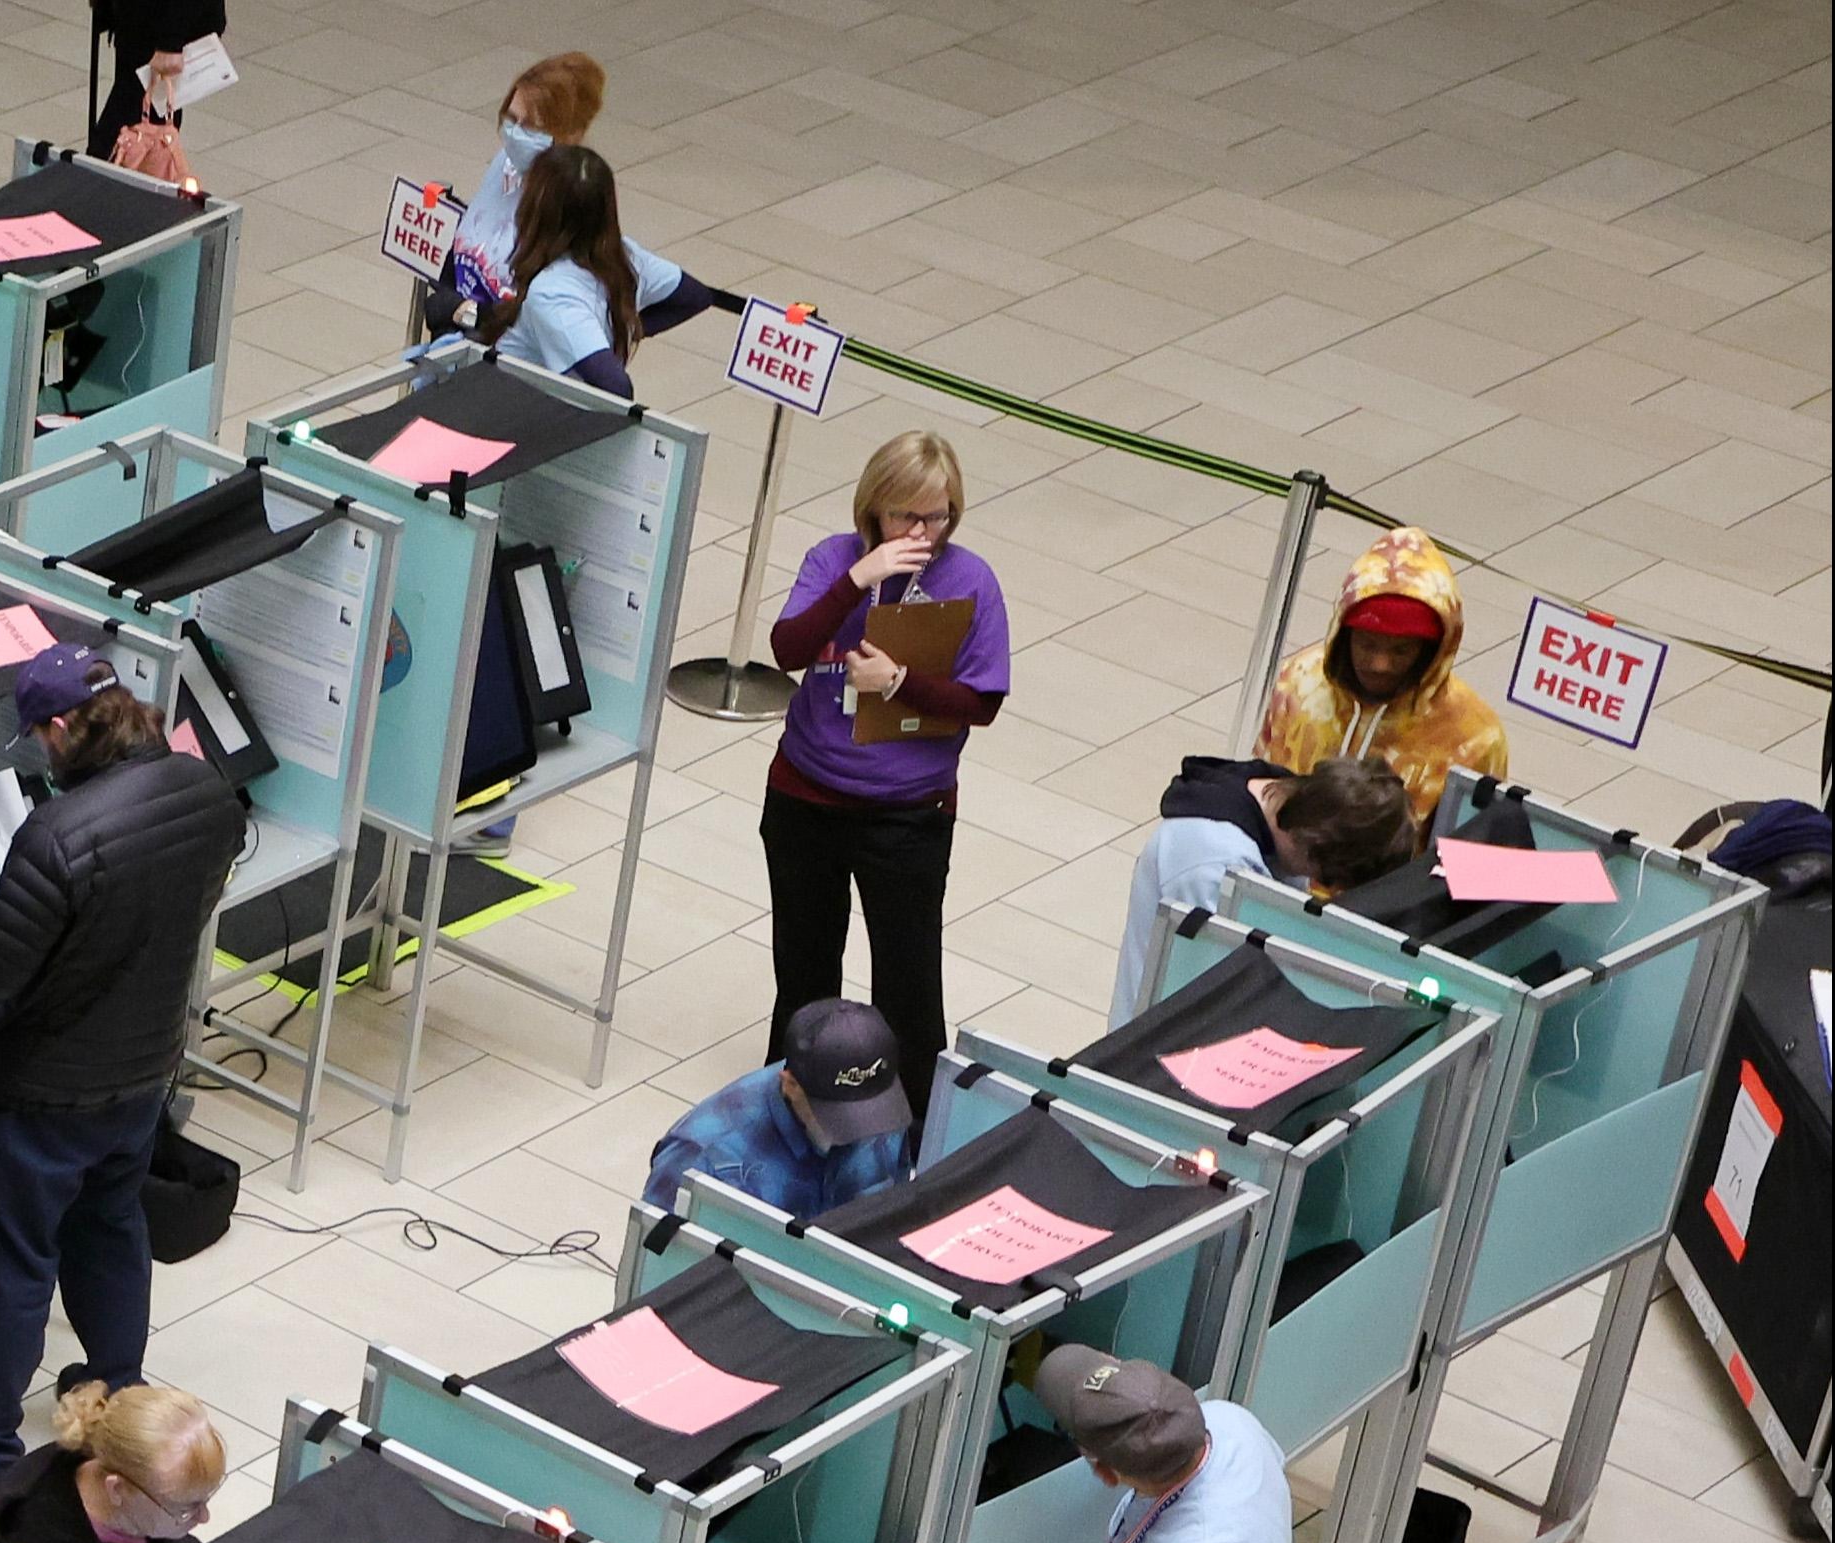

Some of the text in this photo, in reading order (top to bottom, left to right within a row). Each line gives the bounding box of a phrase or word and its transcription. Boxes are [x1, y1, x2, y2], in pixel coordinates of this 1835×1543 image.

[402, 201, 445, 238] EXIT
[394, 225, 443, 267] HERE
[758, 324, 818, 363] EXIT
[746, 348, 815, 392] HERE
[1538, 624, 1643, 686] EXIT
[1534, 668, 1625, 722] HERE
[983, 1225, 1035, 1251] OUT OF
[987, 1200, 1084, 1247] TEMPORARILY
